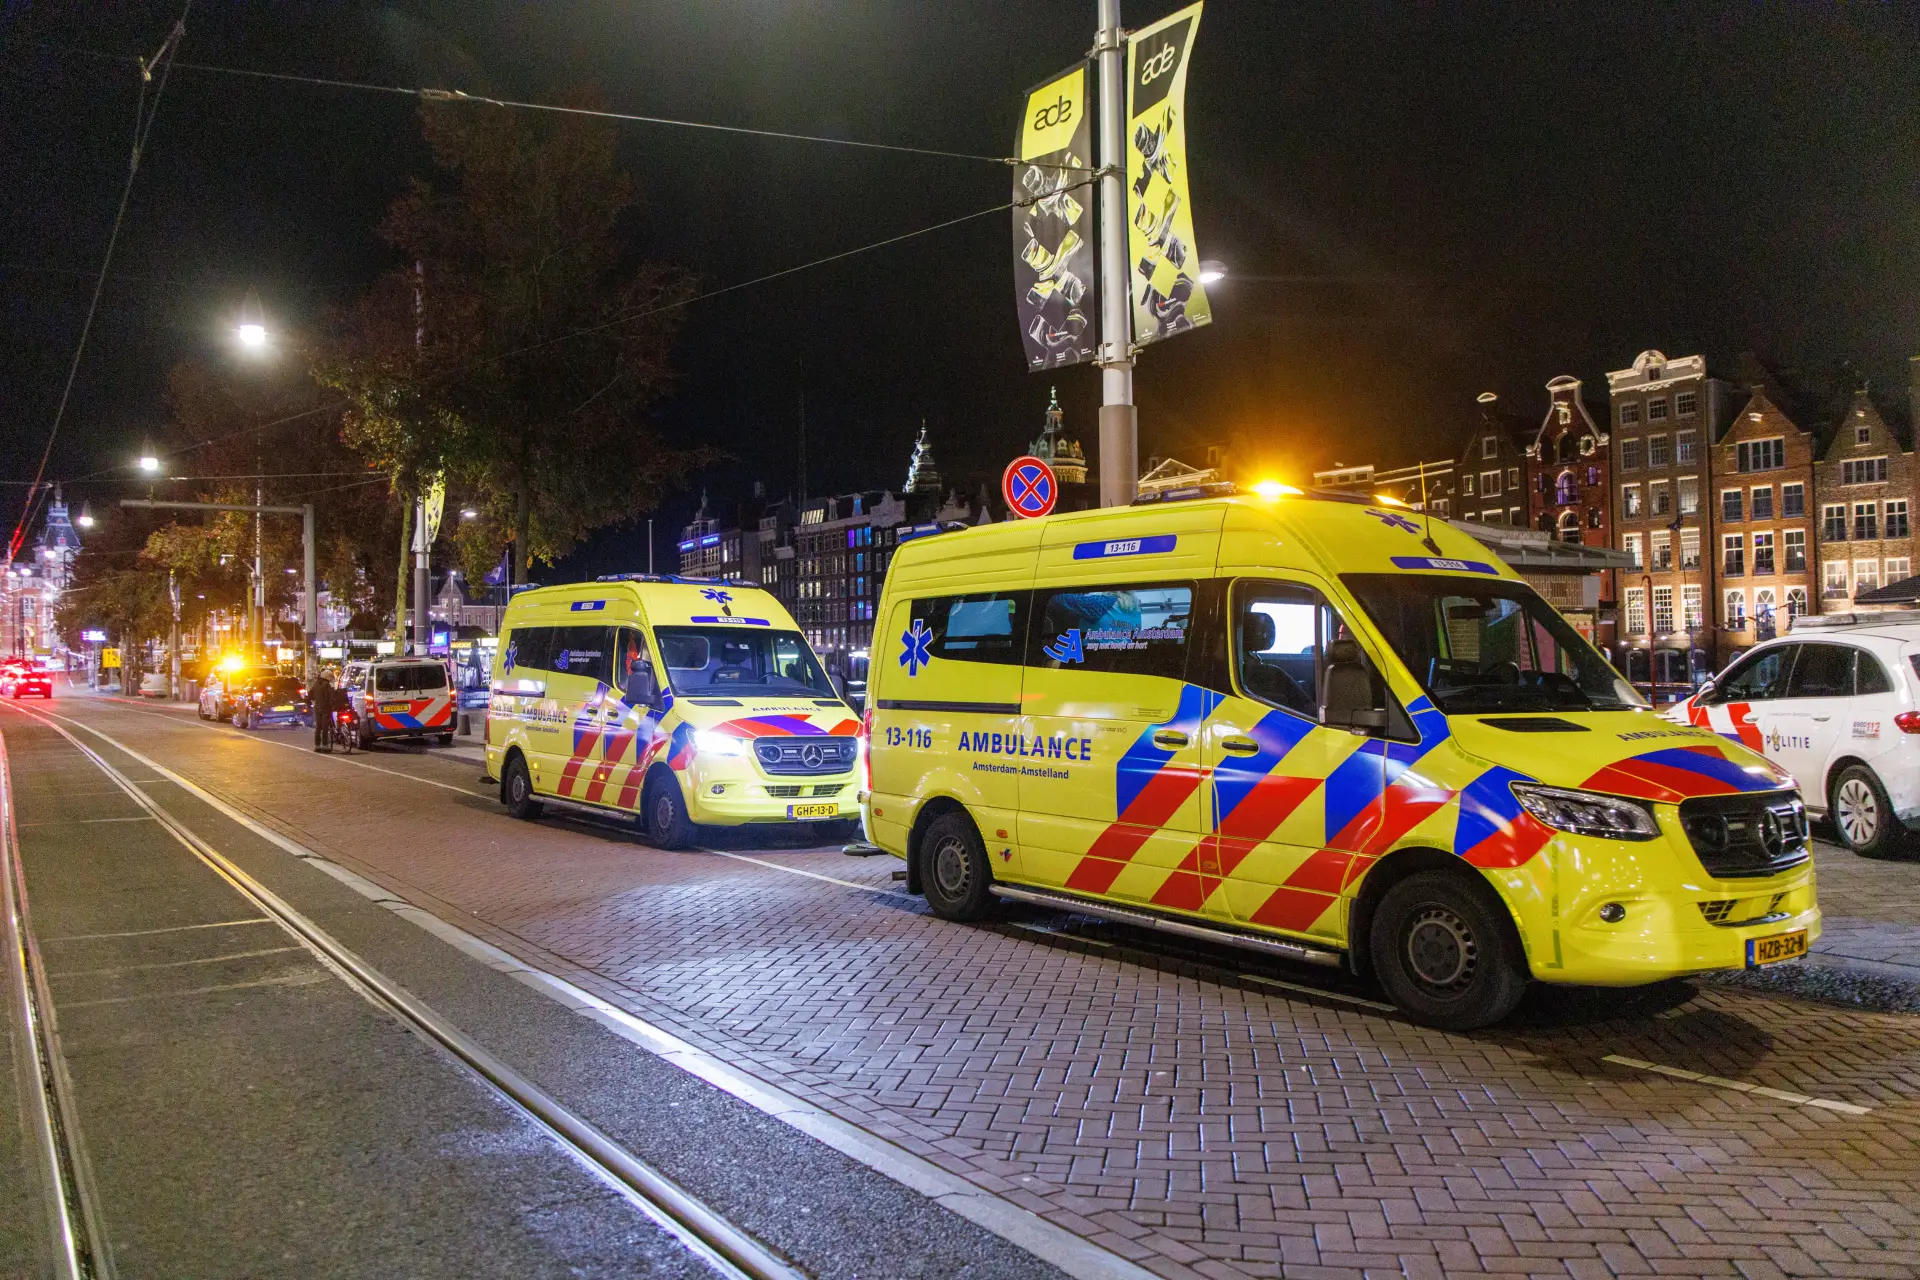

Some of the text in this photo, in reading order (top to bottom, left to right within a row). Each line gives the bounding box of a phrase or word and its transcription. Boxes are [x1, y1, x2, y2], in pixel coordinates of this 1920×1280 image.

[1110, 542, 1136, 553] 13-116
[1085, 627, 1184, 640] Ambulance Amsterdam
[522, 707, 567, 723] AMBULANCE
[1867, 721, 1881, 733] 112
[886, 726, 932, 748] 13-116
[1616, 730, 1713, 741] AMBULANCE
[958, 731, 1092, 761] AMBULANCE
[1766, 734, 1810, 752] POLITIE
[973, 761, 1069, 779] Amsterdam-Amstelland
[796, 805, 834, 816] GHF-13-D
